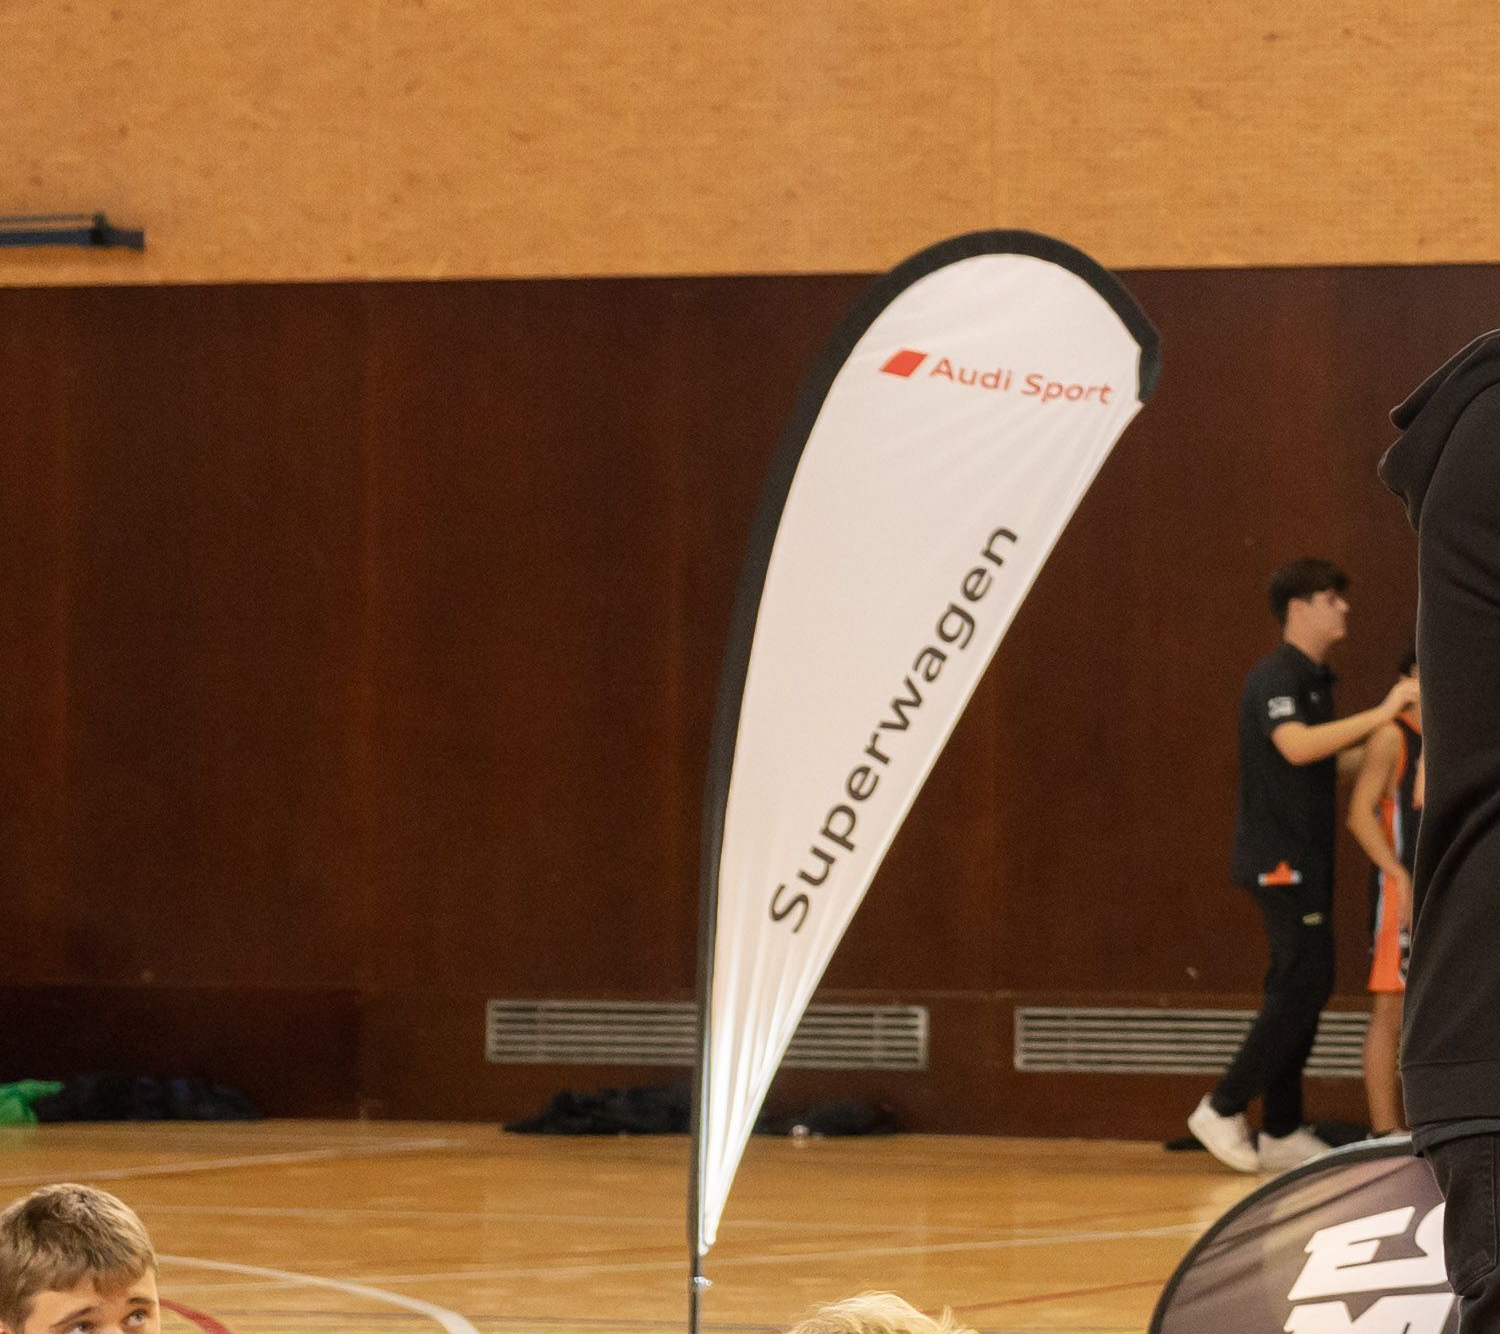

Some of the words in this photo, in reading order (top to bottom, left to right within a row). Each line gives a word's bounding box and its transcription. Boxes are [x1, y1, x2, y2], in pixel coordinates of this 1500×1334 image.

[930, 357, 1013, 392] Audi
[1021, 372, 1115, 407] Sport
[767, 523, 1020, 935] Superwagen
